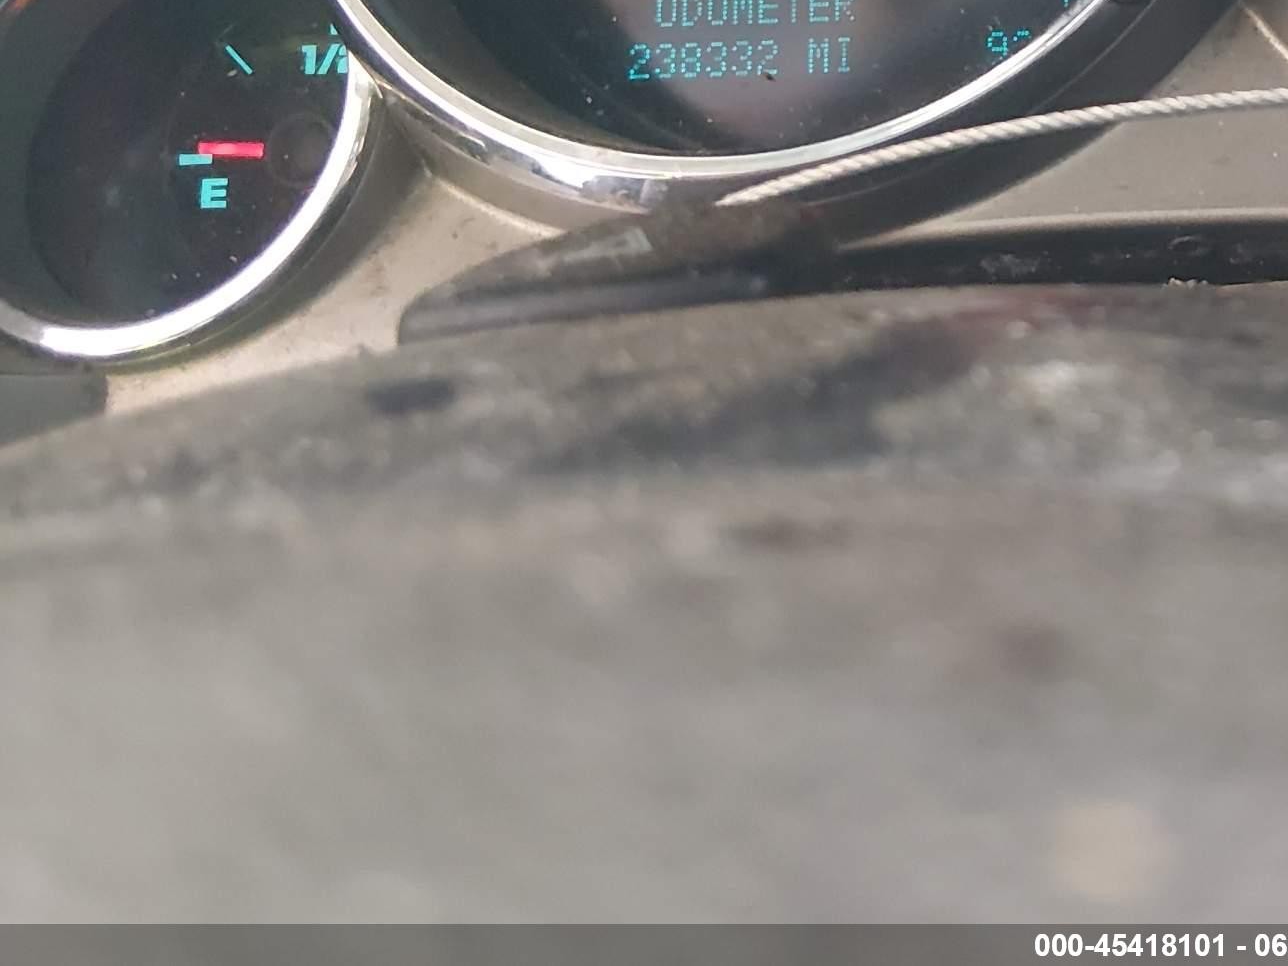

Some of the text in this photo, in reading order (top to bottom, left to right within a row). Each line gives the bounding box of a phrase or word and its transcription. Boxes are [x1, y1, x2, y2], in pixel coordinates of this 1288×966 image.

[628, 36, 851, 80] 238332 MI
[201, 178, 228, 208] E
